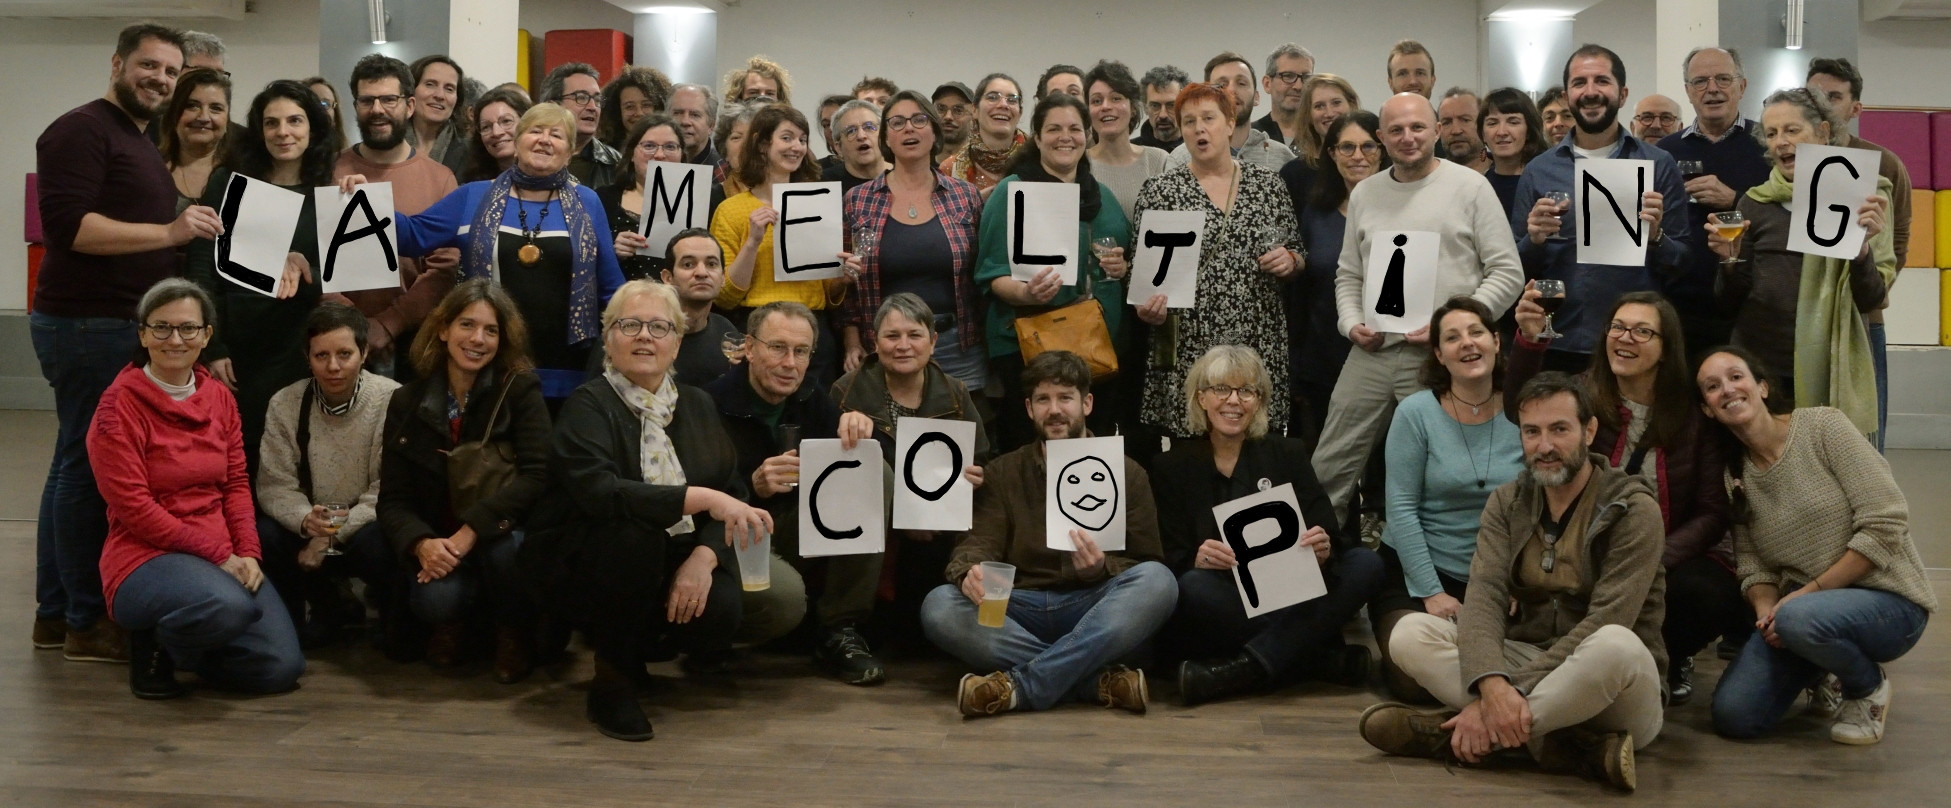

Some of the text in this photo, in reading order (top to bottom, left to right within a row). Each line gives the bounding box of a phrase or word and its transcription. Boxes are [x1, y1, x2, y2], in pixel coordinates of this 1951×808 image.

[217, 174, 276, 293] L
[322, 189, 398, 283] A
[644, 165, 695, 239] M
[780, 188, 842, 274] E
[1012, 189, 1067, 266] L
[1582, 166, 1645, 248] N
[1806, 155, 1860, 248] G
[1144, 229, 1197, 288] T
[809, 459, 864, 540] C
[903, 431, 963, 502] O
[1222, 500, 1300, 609] P
